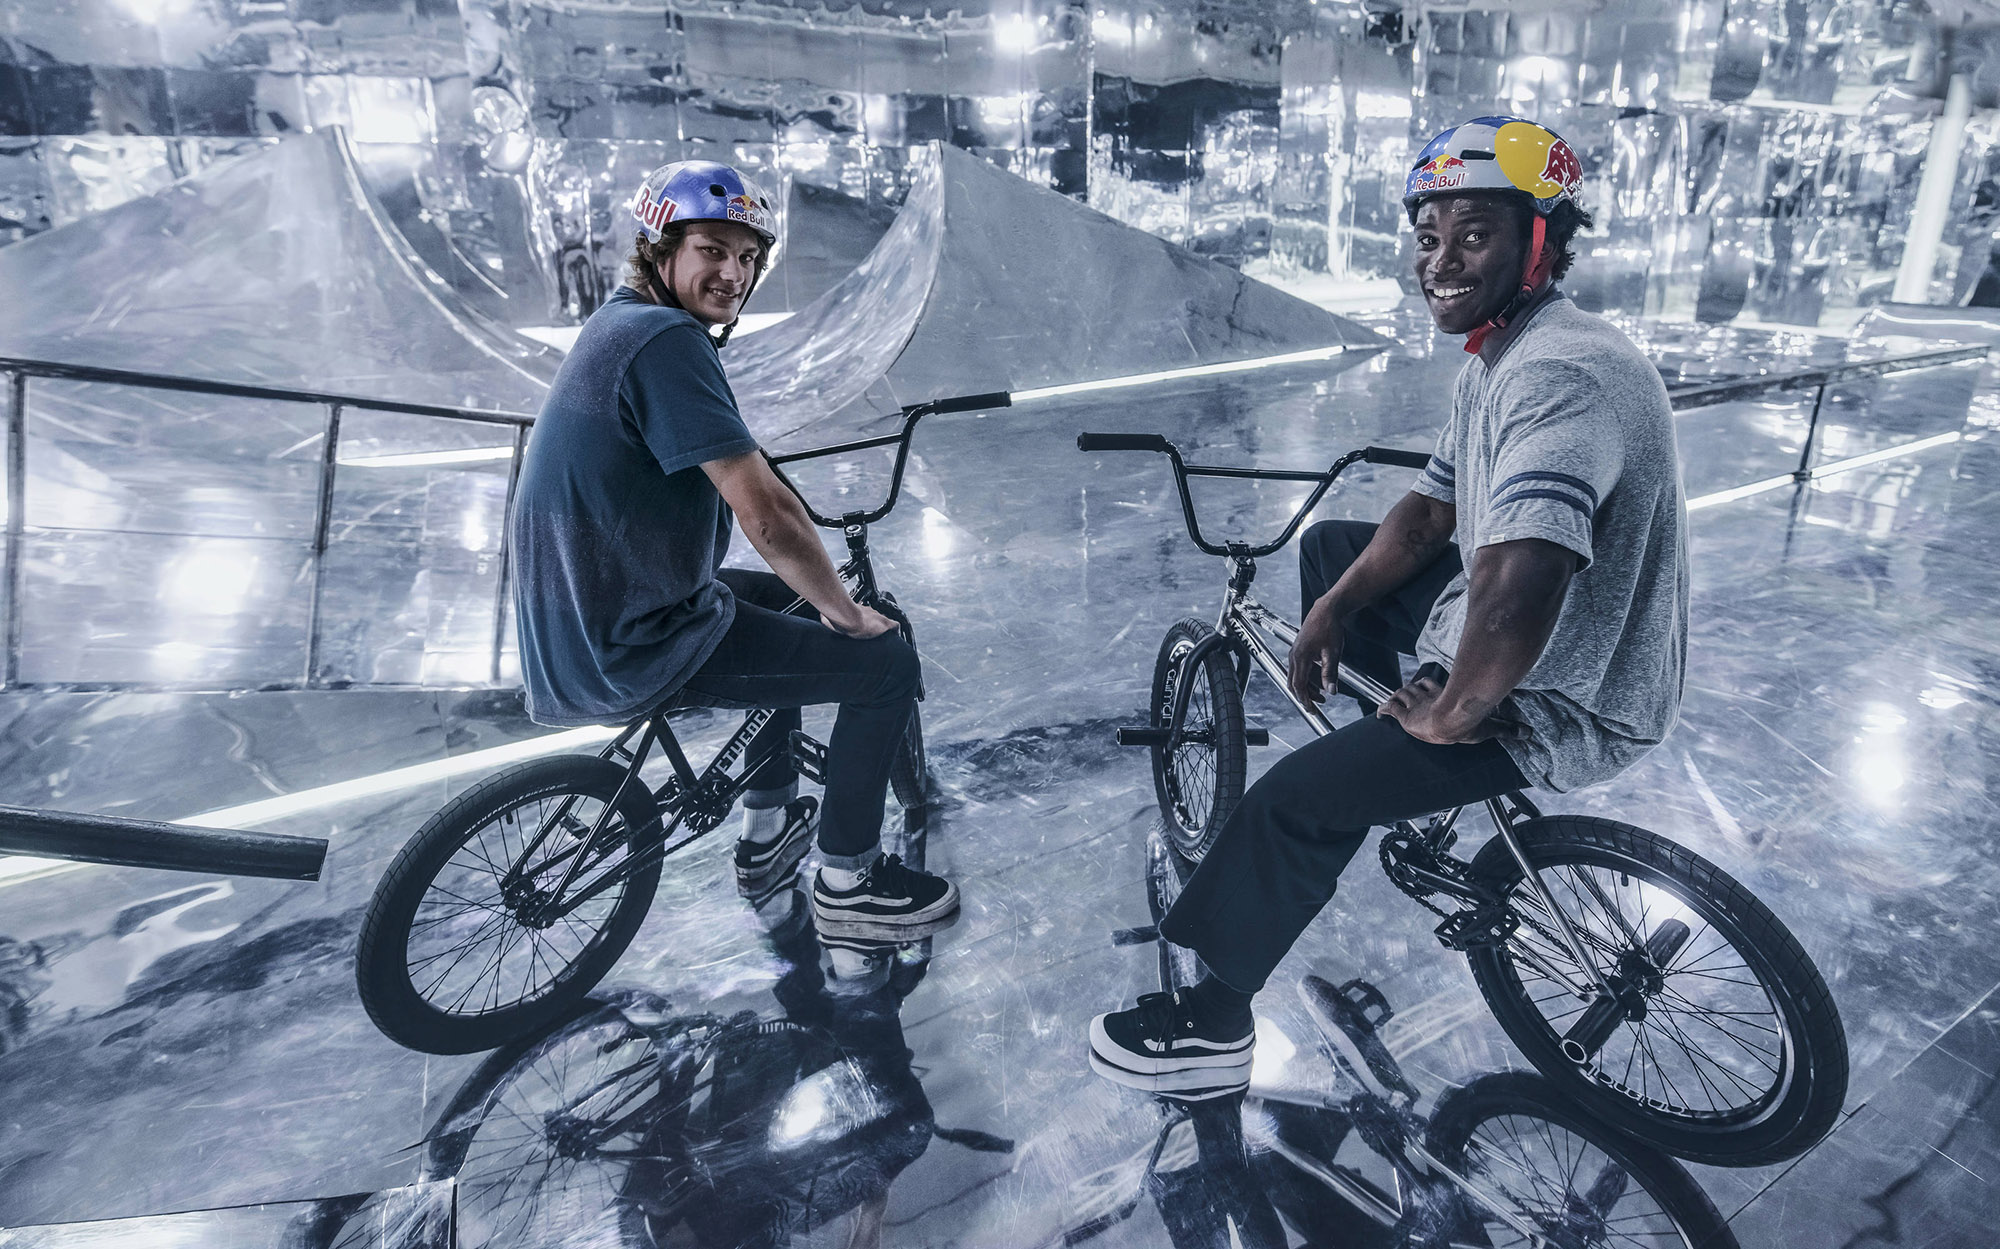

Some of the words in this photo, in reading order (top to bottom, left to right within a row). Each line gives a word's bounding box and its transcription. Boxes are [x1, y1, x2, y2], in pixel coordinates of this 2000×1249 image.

[1416, 177, 1437, 190] Red
[1438, 174, 1465, 188] Bull
[634, 187, 677, 231] Bull
[728, 208, 748, 221] Red
[750, 213, 765, 227] Bull
[1231, 620, 1260, 657] VANS
